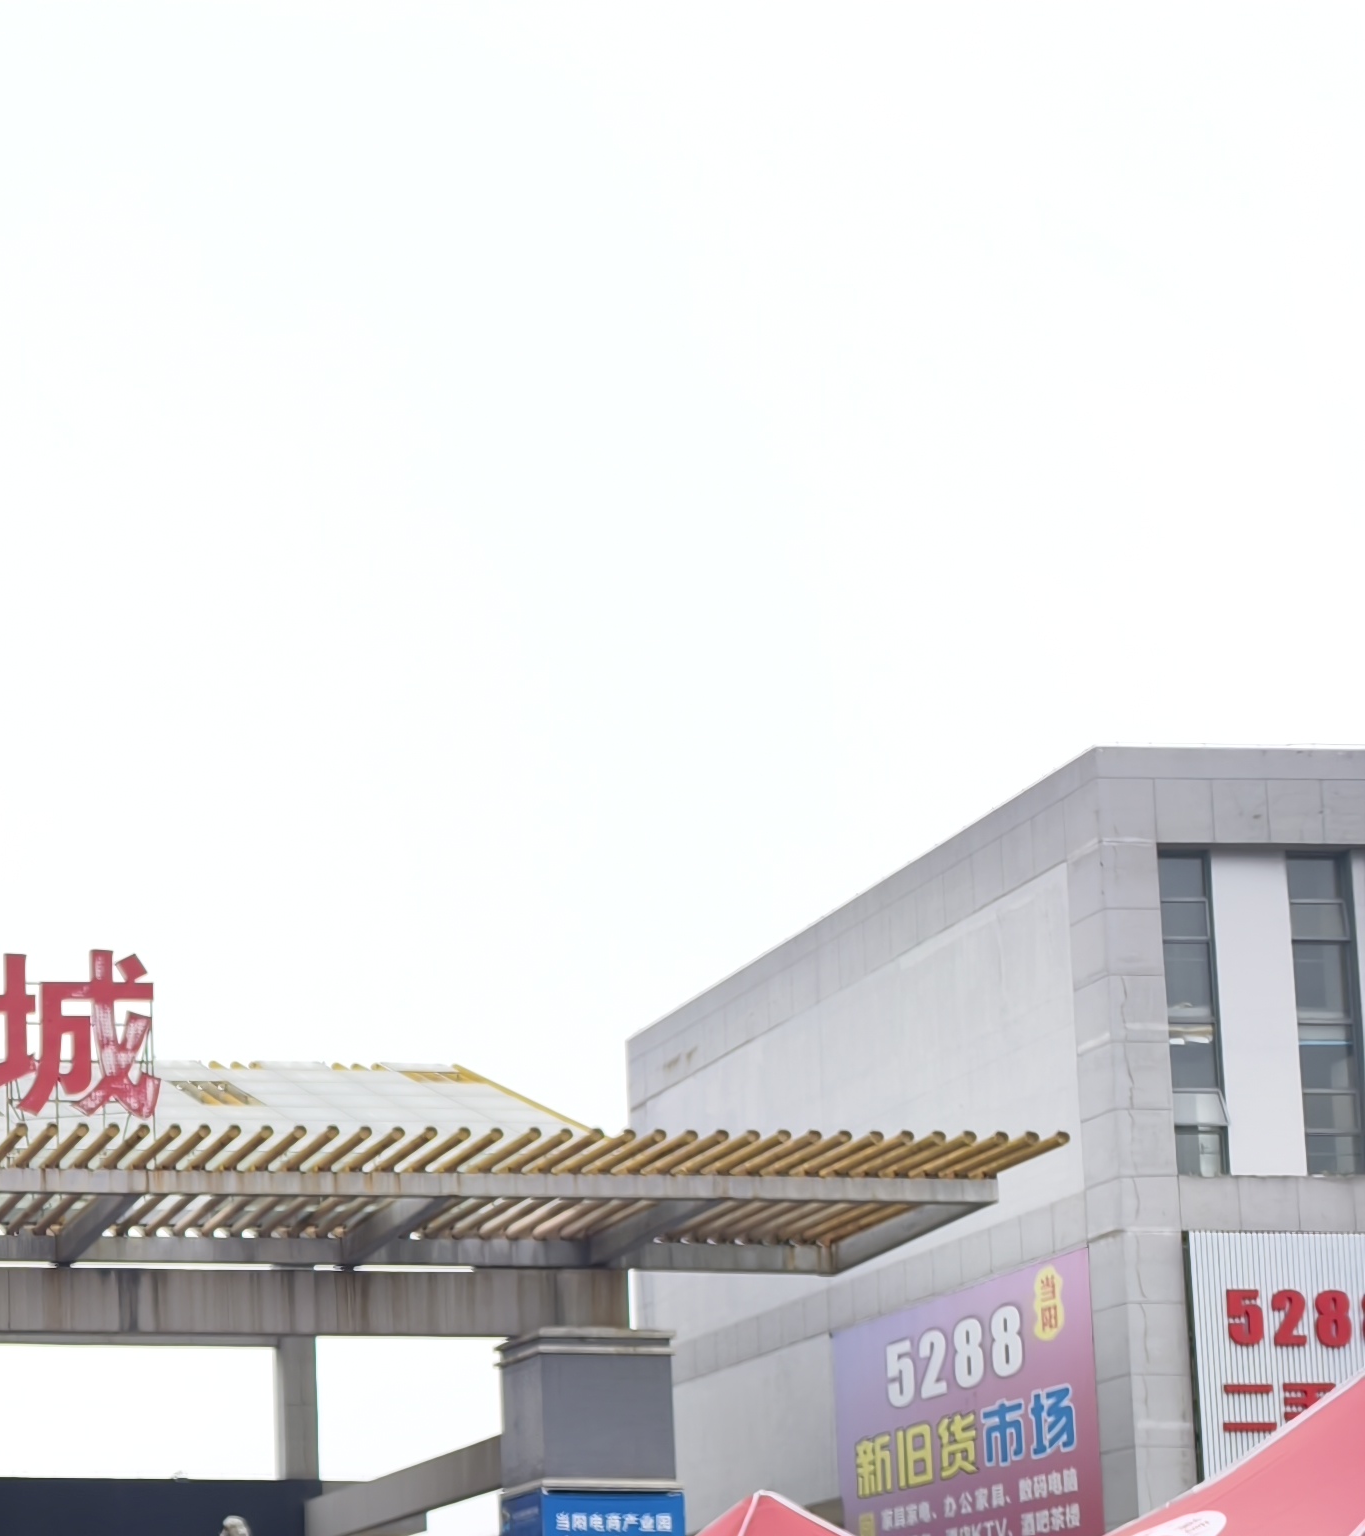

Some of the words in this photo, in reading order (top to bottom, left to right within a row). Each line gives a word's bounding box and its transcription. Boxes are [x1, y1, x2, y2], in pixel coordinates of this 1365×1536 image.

[1040, 1274, 1058, 1332] 当阳
[1225, 1288, 1365, 1350] 528
[886, 1304, 1024, 1408] 5288
[855, 1383, 1077, 1501] 新旧货市场
[555, 1511, 673, 1532] 当阳电商产业园
